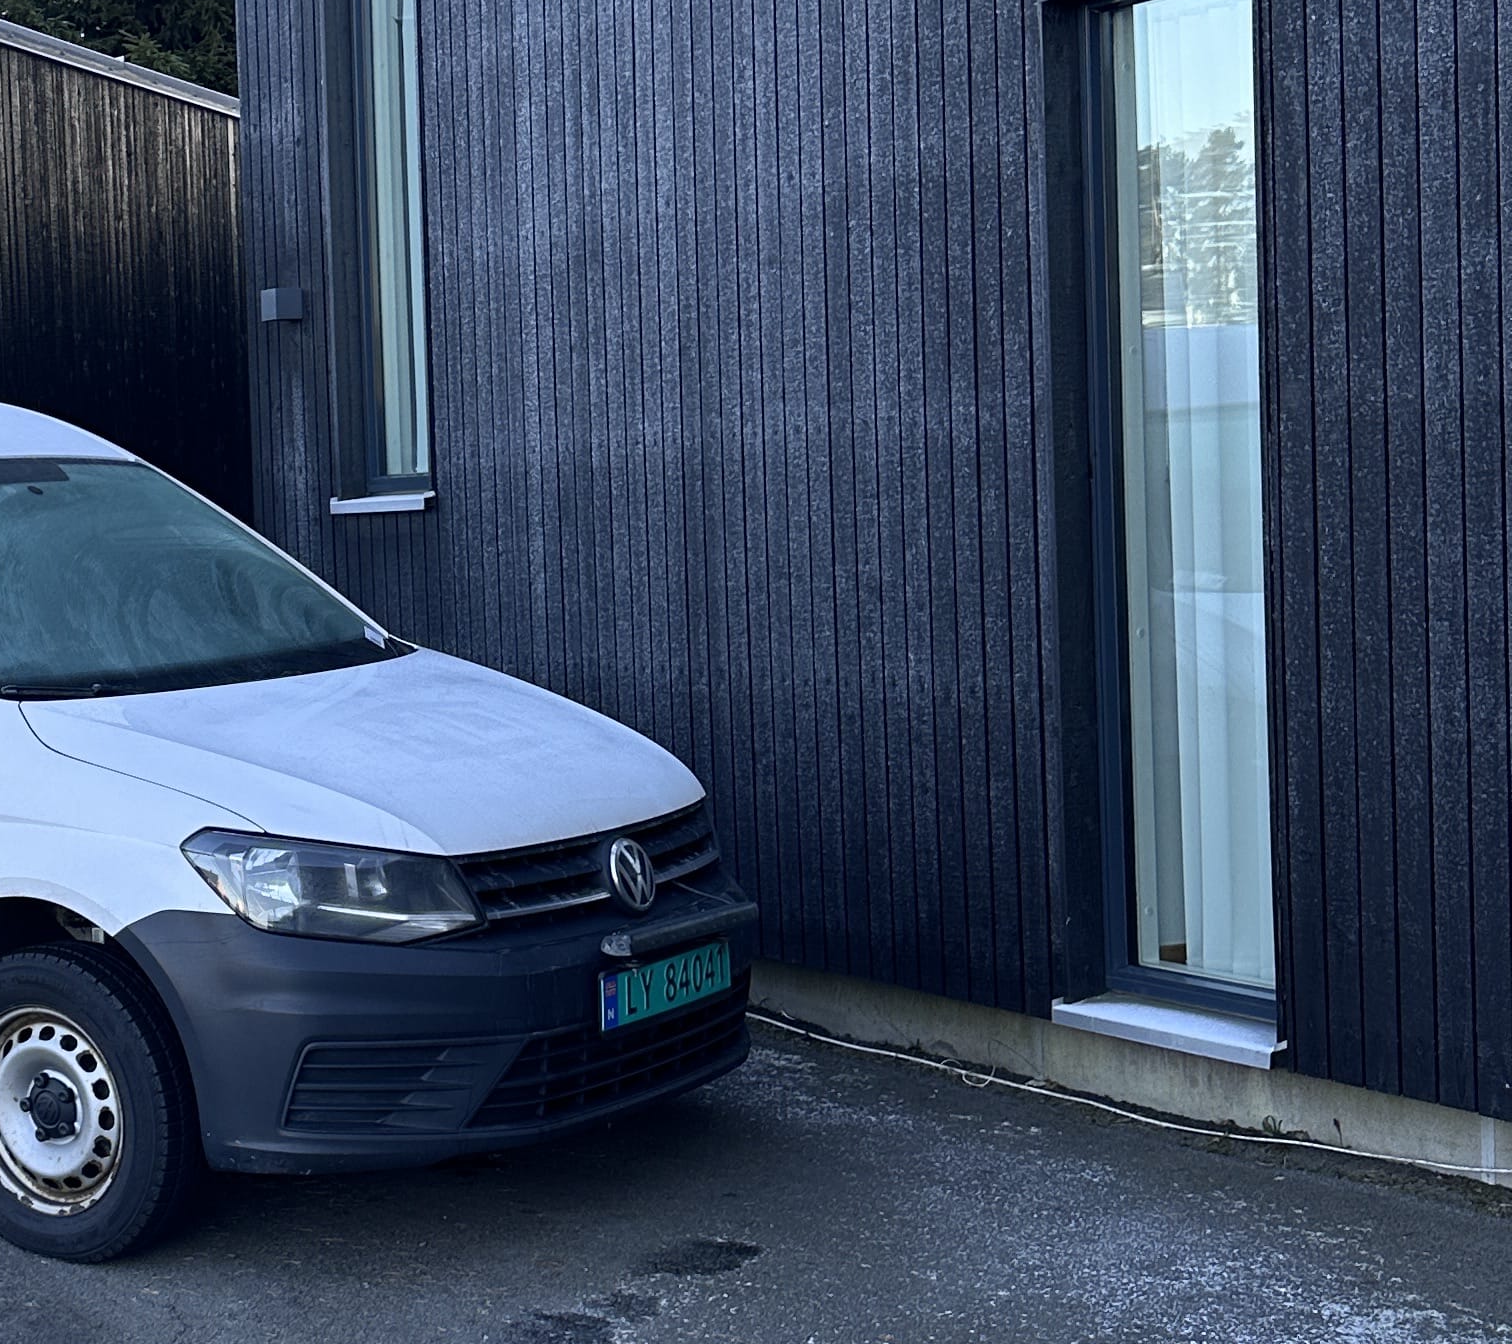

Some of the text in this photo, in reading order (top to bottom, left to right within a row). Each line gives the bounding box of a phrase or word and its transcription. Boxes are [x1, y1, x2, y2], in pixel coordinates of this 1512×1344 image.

[625, 943, 725, 1016] LY 84041
[607, 1008, 615, 1020] N
